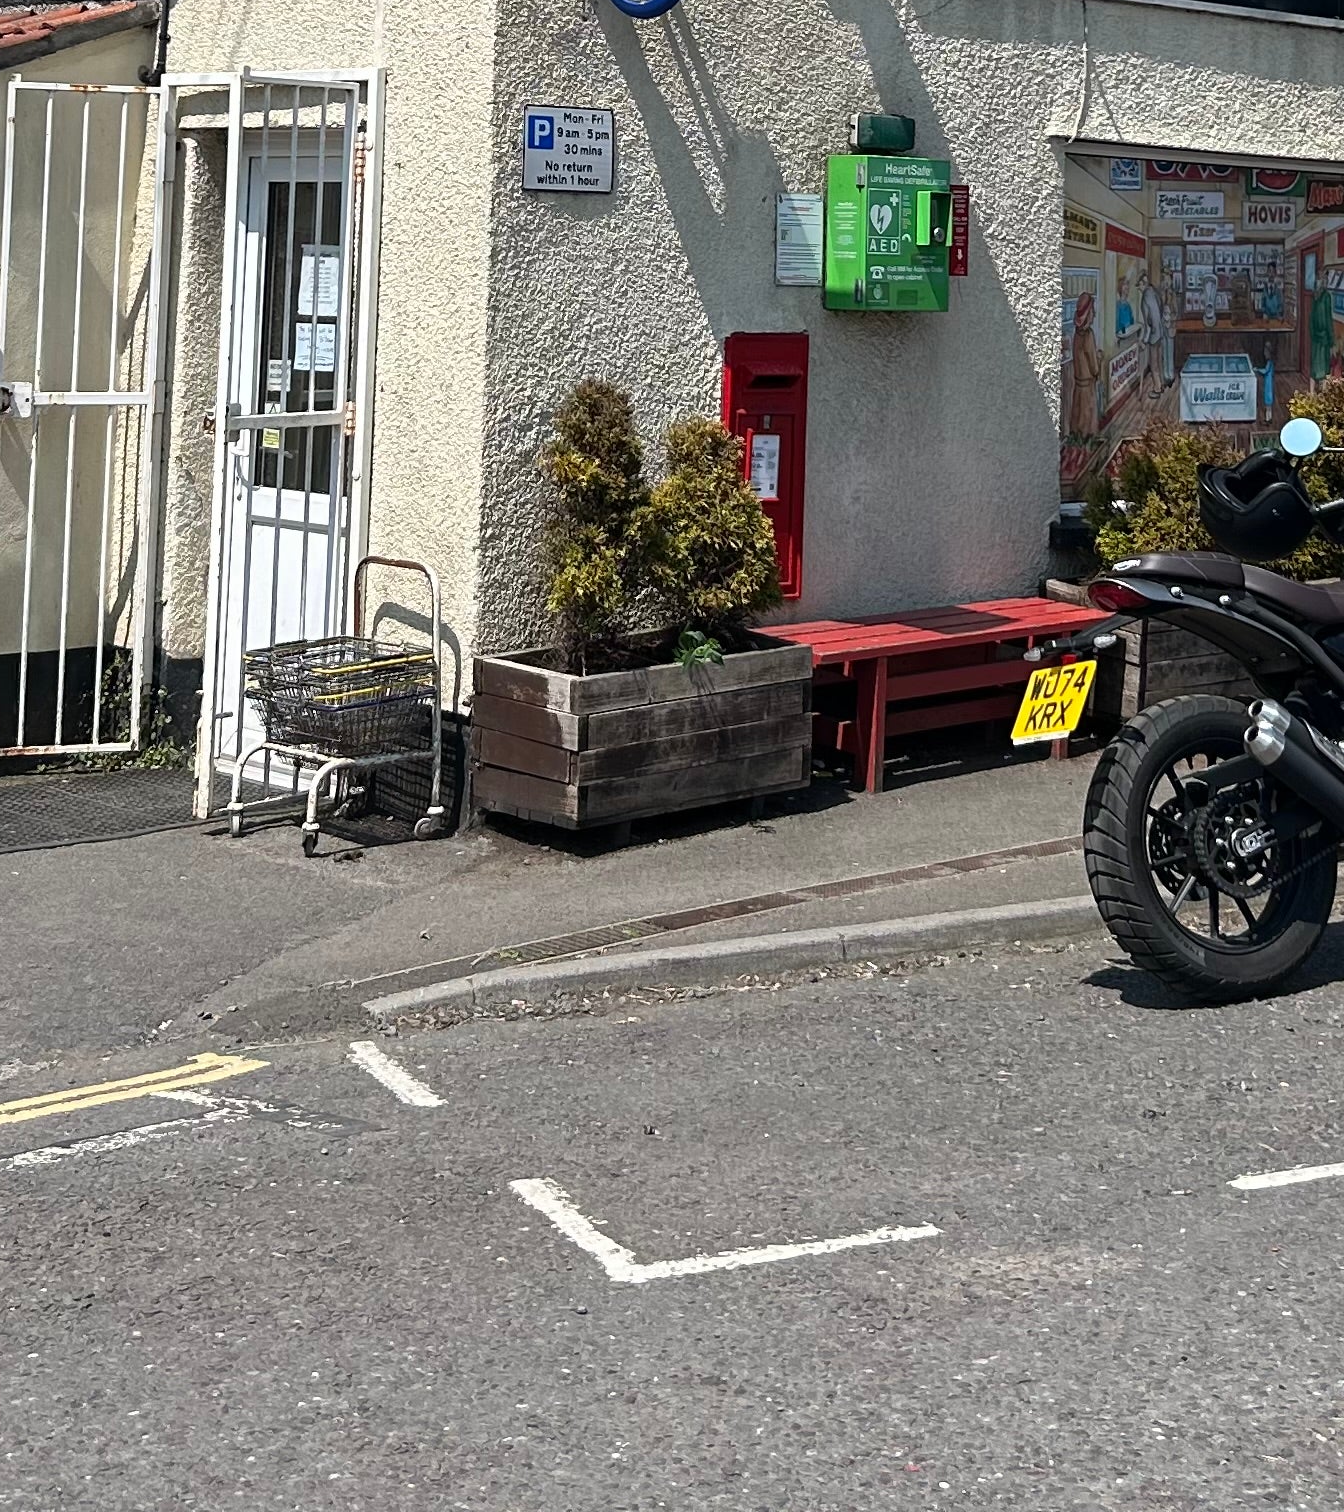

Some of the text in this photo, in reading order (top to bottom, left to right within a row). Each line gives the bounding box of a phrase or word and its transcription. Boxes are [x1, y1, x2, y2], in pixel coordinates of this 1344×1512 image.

[563, 113, 584, 124] Mon
[591, 114, 604, 125] Fri
[564, 144, 603, 156] 30 mins
[545, 160, 593, 173] No return
[885, 163, 931, 176] HeartSafe
[537, 174, 567, 185] within
[578, 175, 600, 186] hour
[1247, 204, 1291, 224] HOVIS
[869, 238, 898, 252] AED
[1023, 698, 1074, 733] KRX
